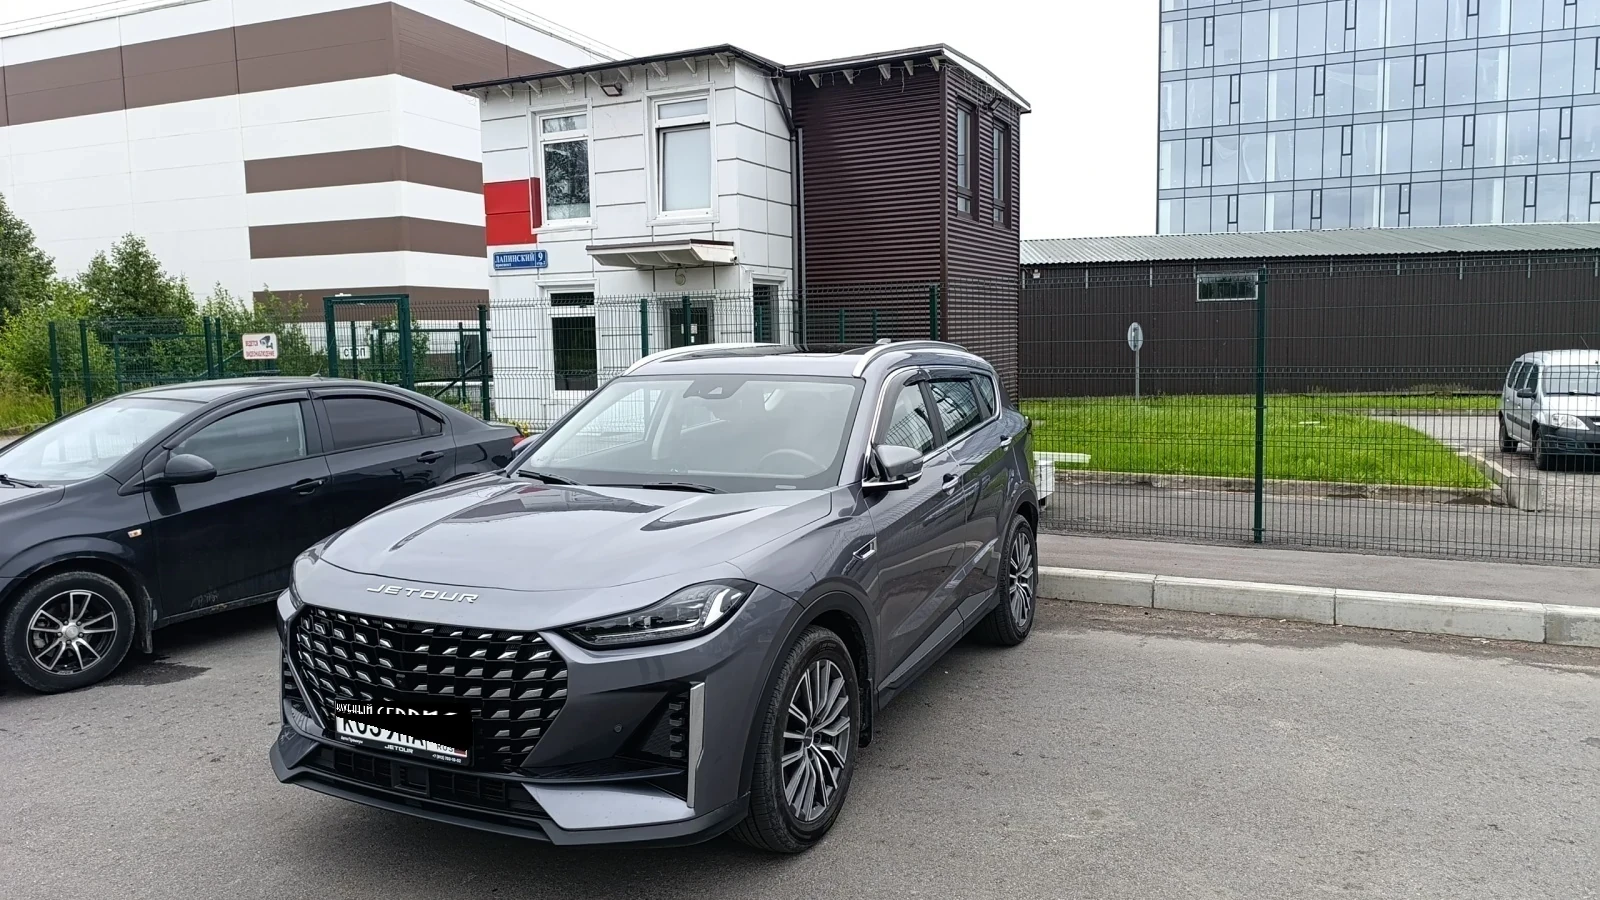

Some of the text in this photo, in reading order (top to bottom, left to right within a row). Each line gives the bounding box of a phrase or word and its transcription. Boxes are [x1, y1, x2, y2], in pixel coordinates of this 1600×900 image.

[495, 252, 534, 263] ЛАПИНСКИЙ
[538, 252, 543, 262] 9
[367, 583, 479, 604] JETOUR
[384, 744, 414, 754] JETOUR
